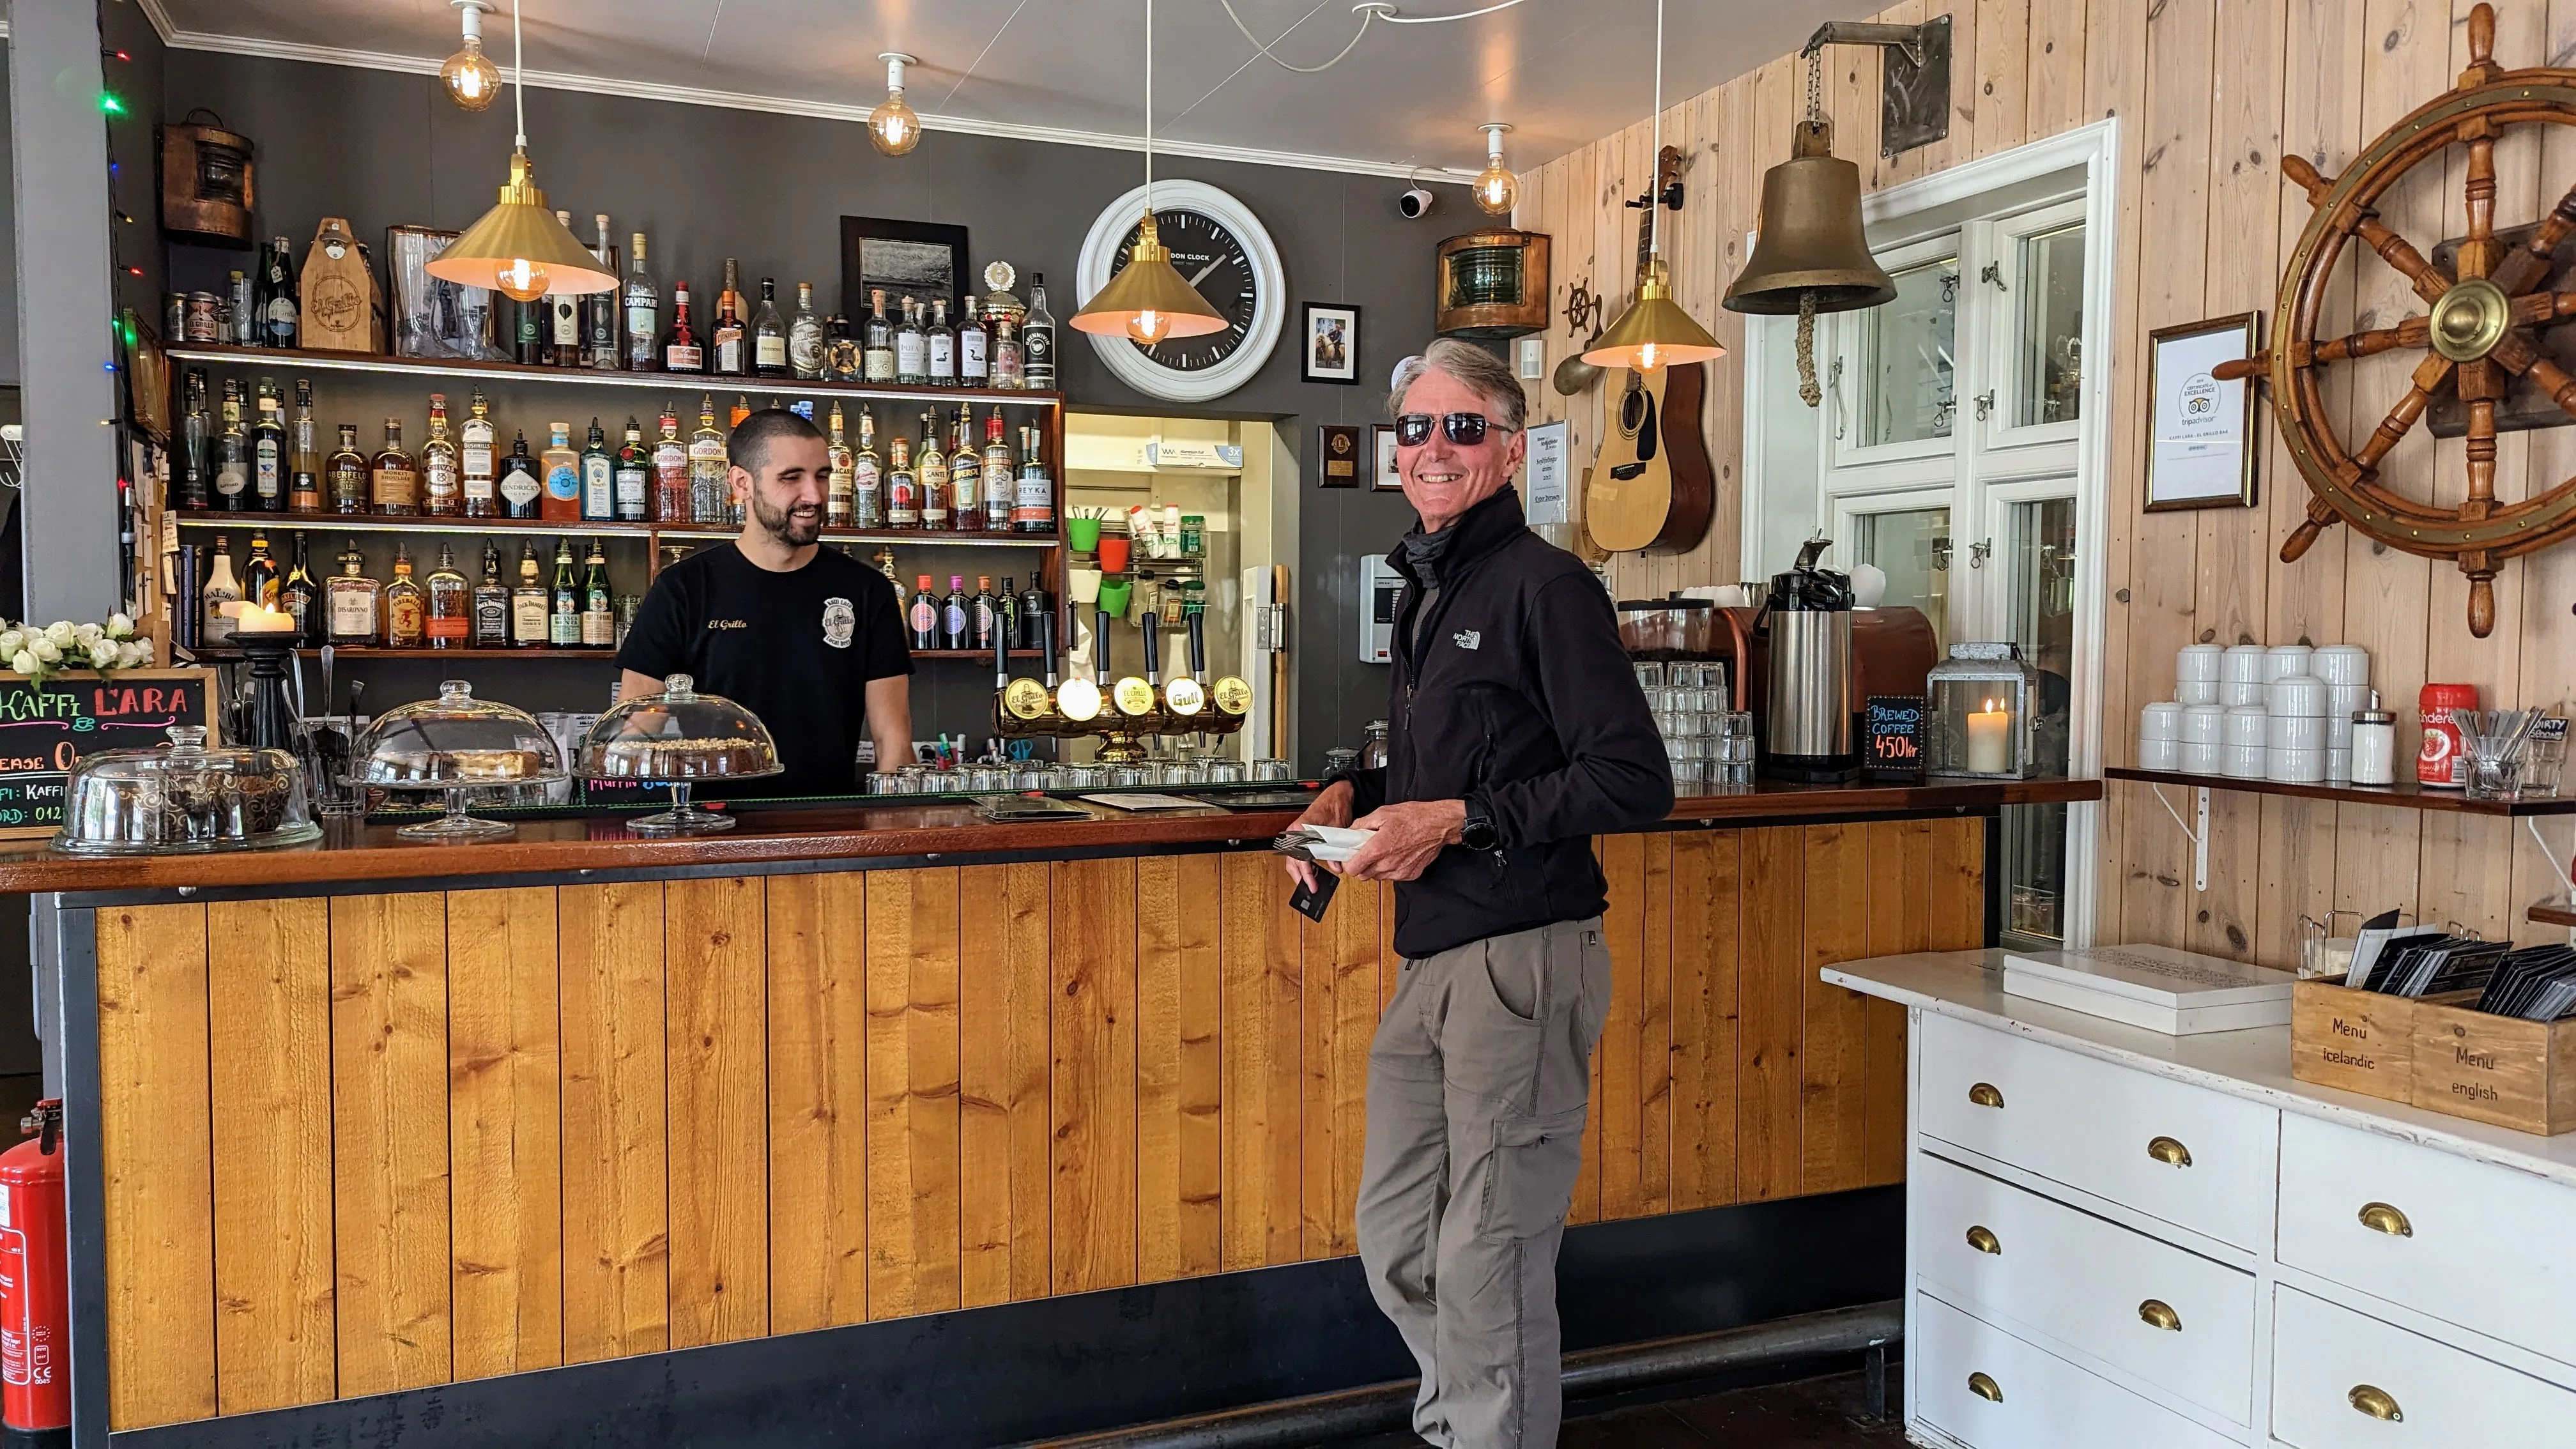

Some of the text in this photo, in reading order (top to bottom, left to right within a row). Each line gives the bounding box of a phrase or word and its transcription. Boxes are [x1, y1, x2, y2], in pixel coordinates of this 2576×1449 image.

[1187, 253, 1210, 261] CLOCK
[624, 296, 657, 308] CAMPARI
[2184, 387, 2216, 397] EXCELLENCE
[2182, 416, 2215, 427] tripadvisor
[693, 447, 724, 456] GORDON'S
[1227, 447, 1239, 457] 3x
[657, 454, 685, 463] GORDON'S
[984, 457, 1012, 466] SMIRNOFF
[953, 468, 979, 480] APEROL
[204, 590, 237, 602] MALIBU
[394, 598, 420, 608] FIREBALL
[518, 601, 529, 611] JACK
[709, 619, 748, 631] El Grillo
[1011, 693, 1044, 703] El Grillo
[1173, 691, 1199, 707] Gull
[1228, 689, 1249, 700] Grillo
[0, 690, 80, 721] KAFFI
[1870, 705, 1920, 723] BREWED
[1872, 723, 1914, 735] COFFEE
[2535, 719, 2566, 730] DIRTY
[1876, 734, 1919, 758] 450kr
[35, 806, 65, 822] 012
[2333, 1016, 2368, 1040] Menu
[2322, 1046, 2375, 1070] icelandic
[2455, 1045, 2495, 1070] Menu
[2451, 1081, 2499, 1102] english
